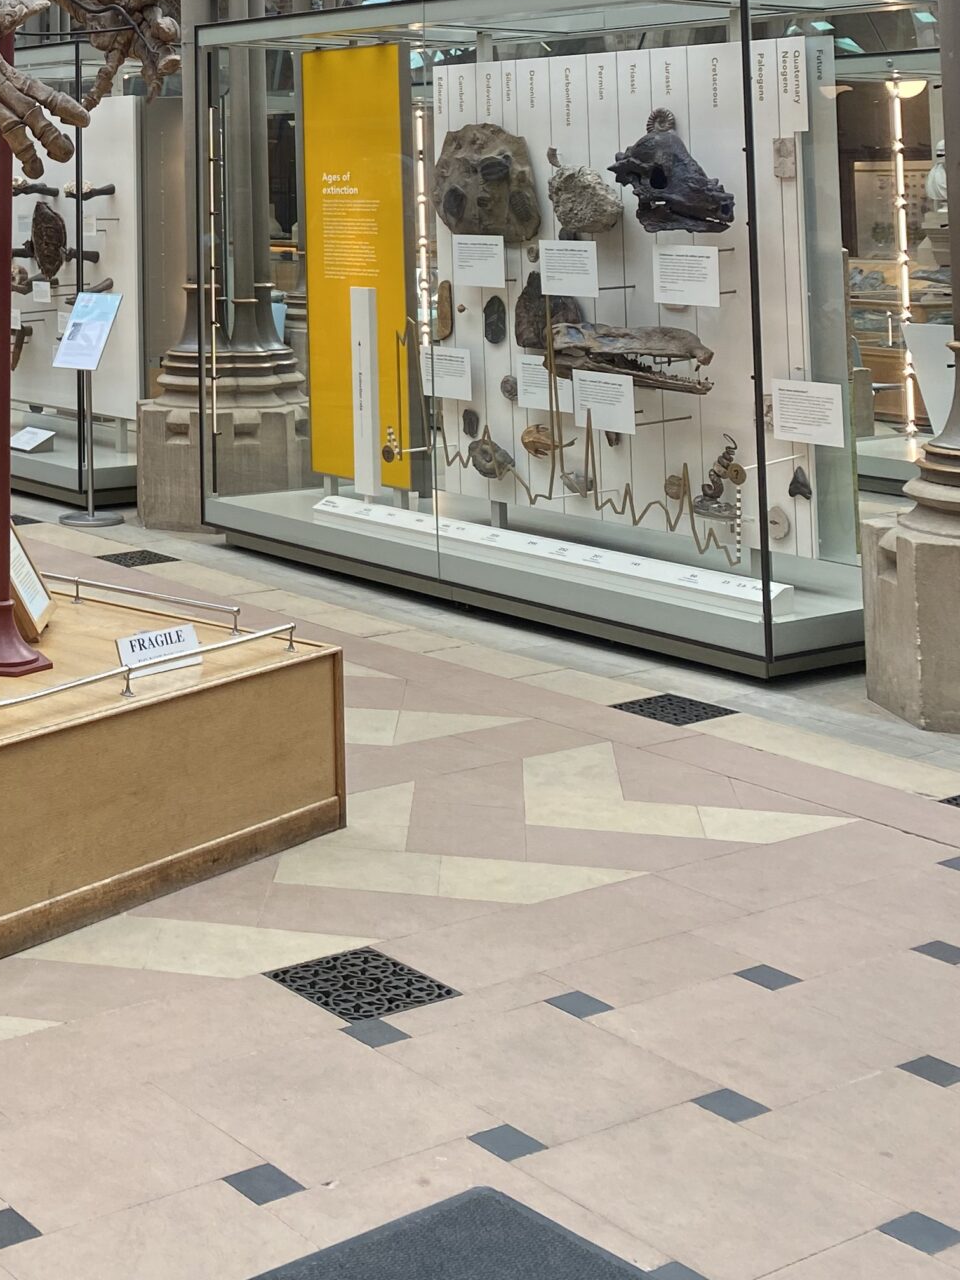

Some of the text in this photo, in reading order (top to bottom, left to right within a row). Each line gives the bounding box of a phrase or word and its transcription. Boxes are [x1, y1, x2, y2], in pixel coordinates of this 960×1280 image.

[322, 171, 351, 184] Ages of
[322, 185, 359, 195] extinction
[129, 629, 185, 653] FRAGILE
